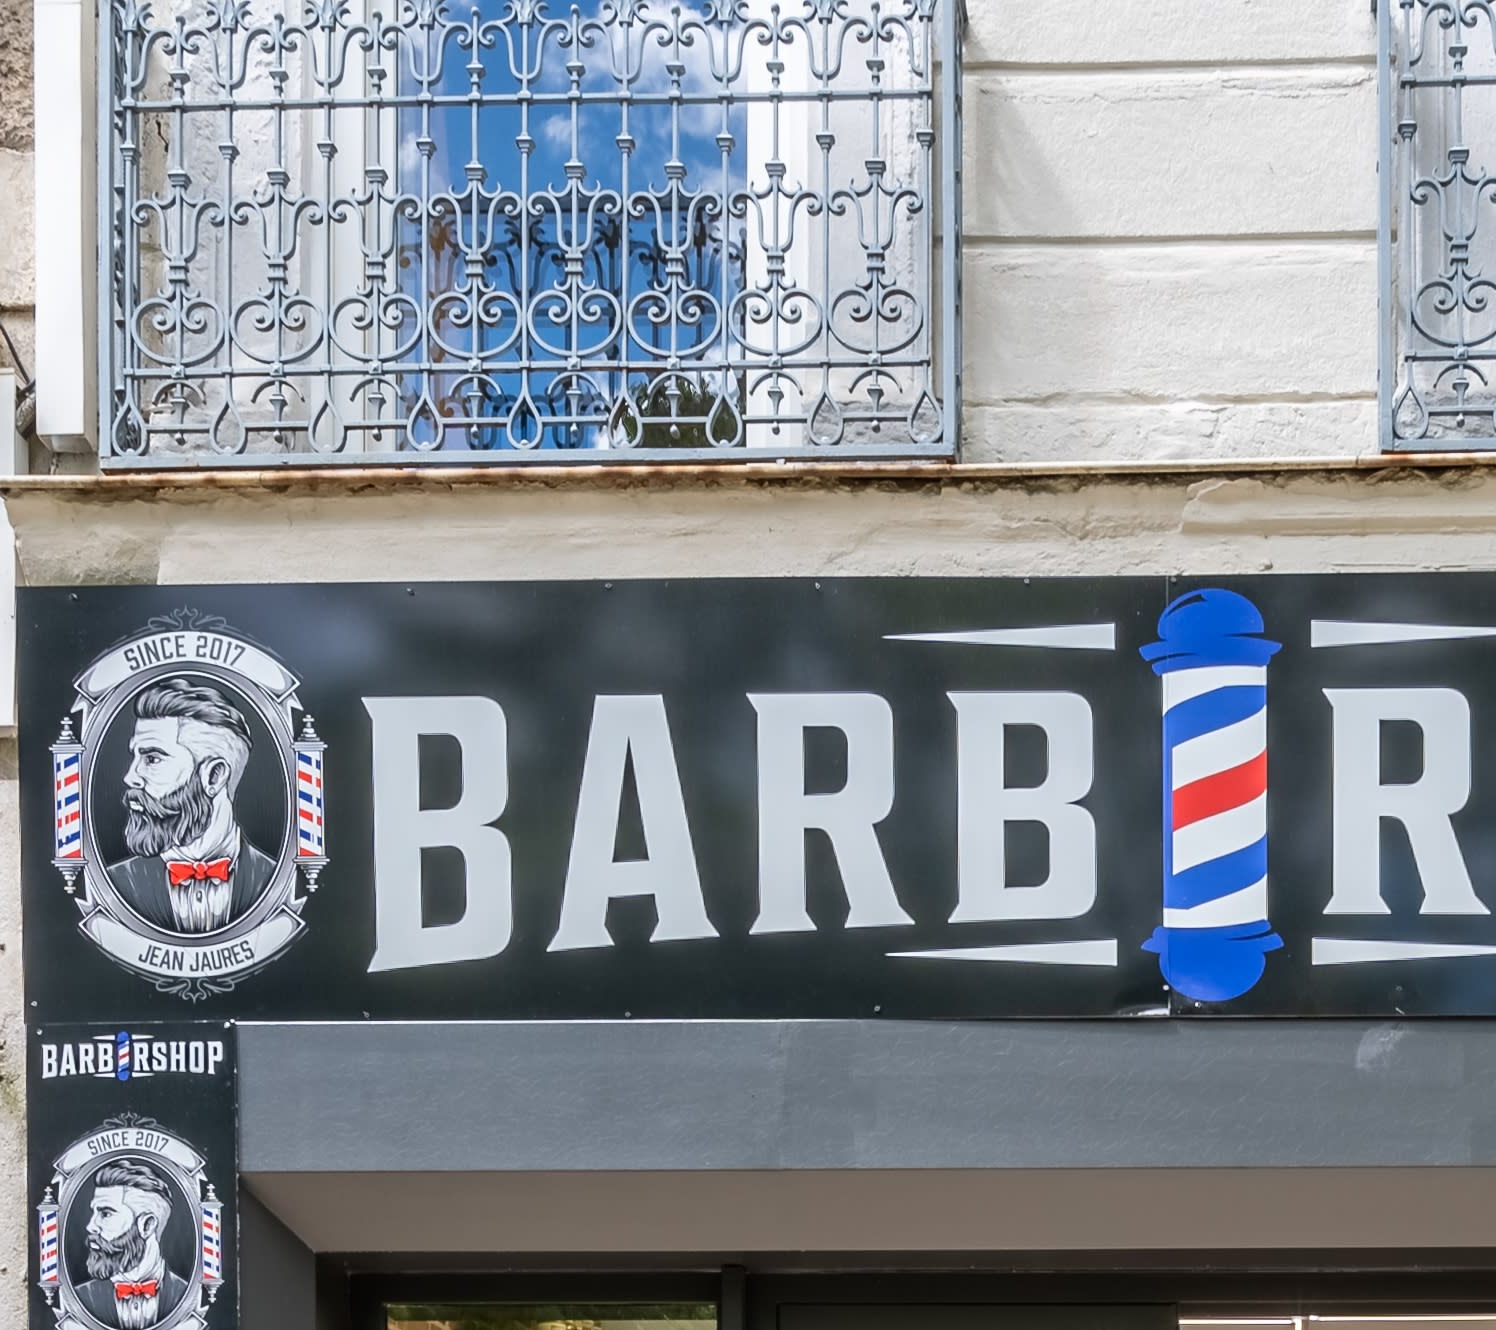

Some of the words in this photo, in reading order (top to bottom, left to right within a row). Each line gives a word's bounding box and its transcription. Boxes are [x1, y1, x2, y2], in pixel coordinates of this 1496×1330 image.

[124, 635, 187, 671] SINCE
[194, 635, 246, 666] 2017
[138, 944, 184, 971] JEAN
[190, 940, 255, 972] JAURES
[87, 1132, 129, 1156] SINCE
[135, 1131, 170, 1153] 2017
